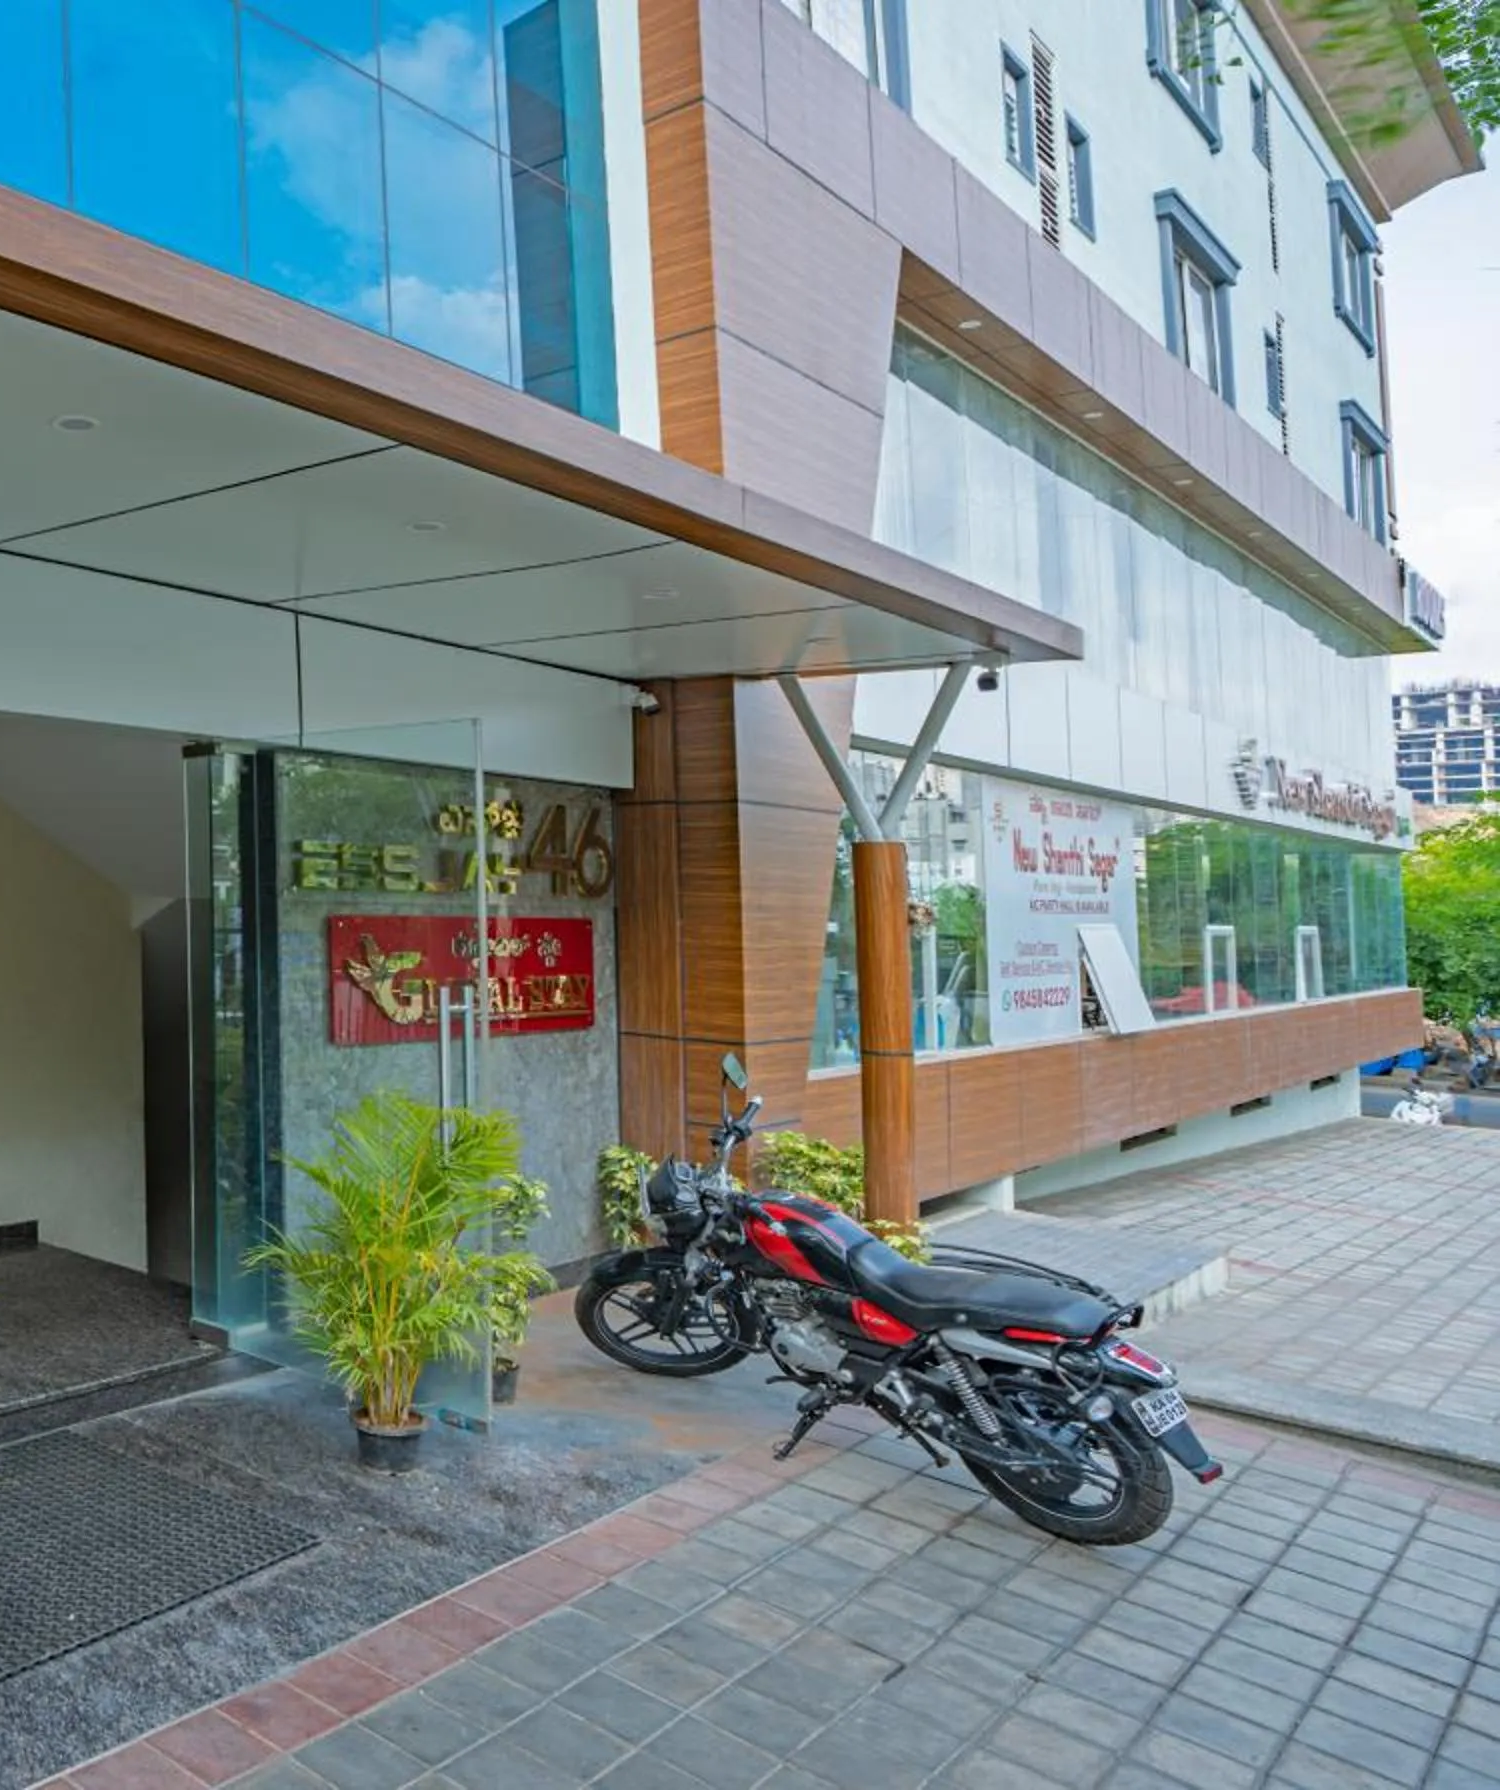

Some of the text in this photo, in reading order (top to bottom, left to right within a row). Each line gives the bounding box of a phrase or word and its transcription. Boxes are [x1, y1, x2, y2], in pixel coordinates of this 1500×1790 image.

[524, 804, 613, 898] 46
[1013, 828, 1038, 874] New
[527, 975, 590, 1009] STAY
